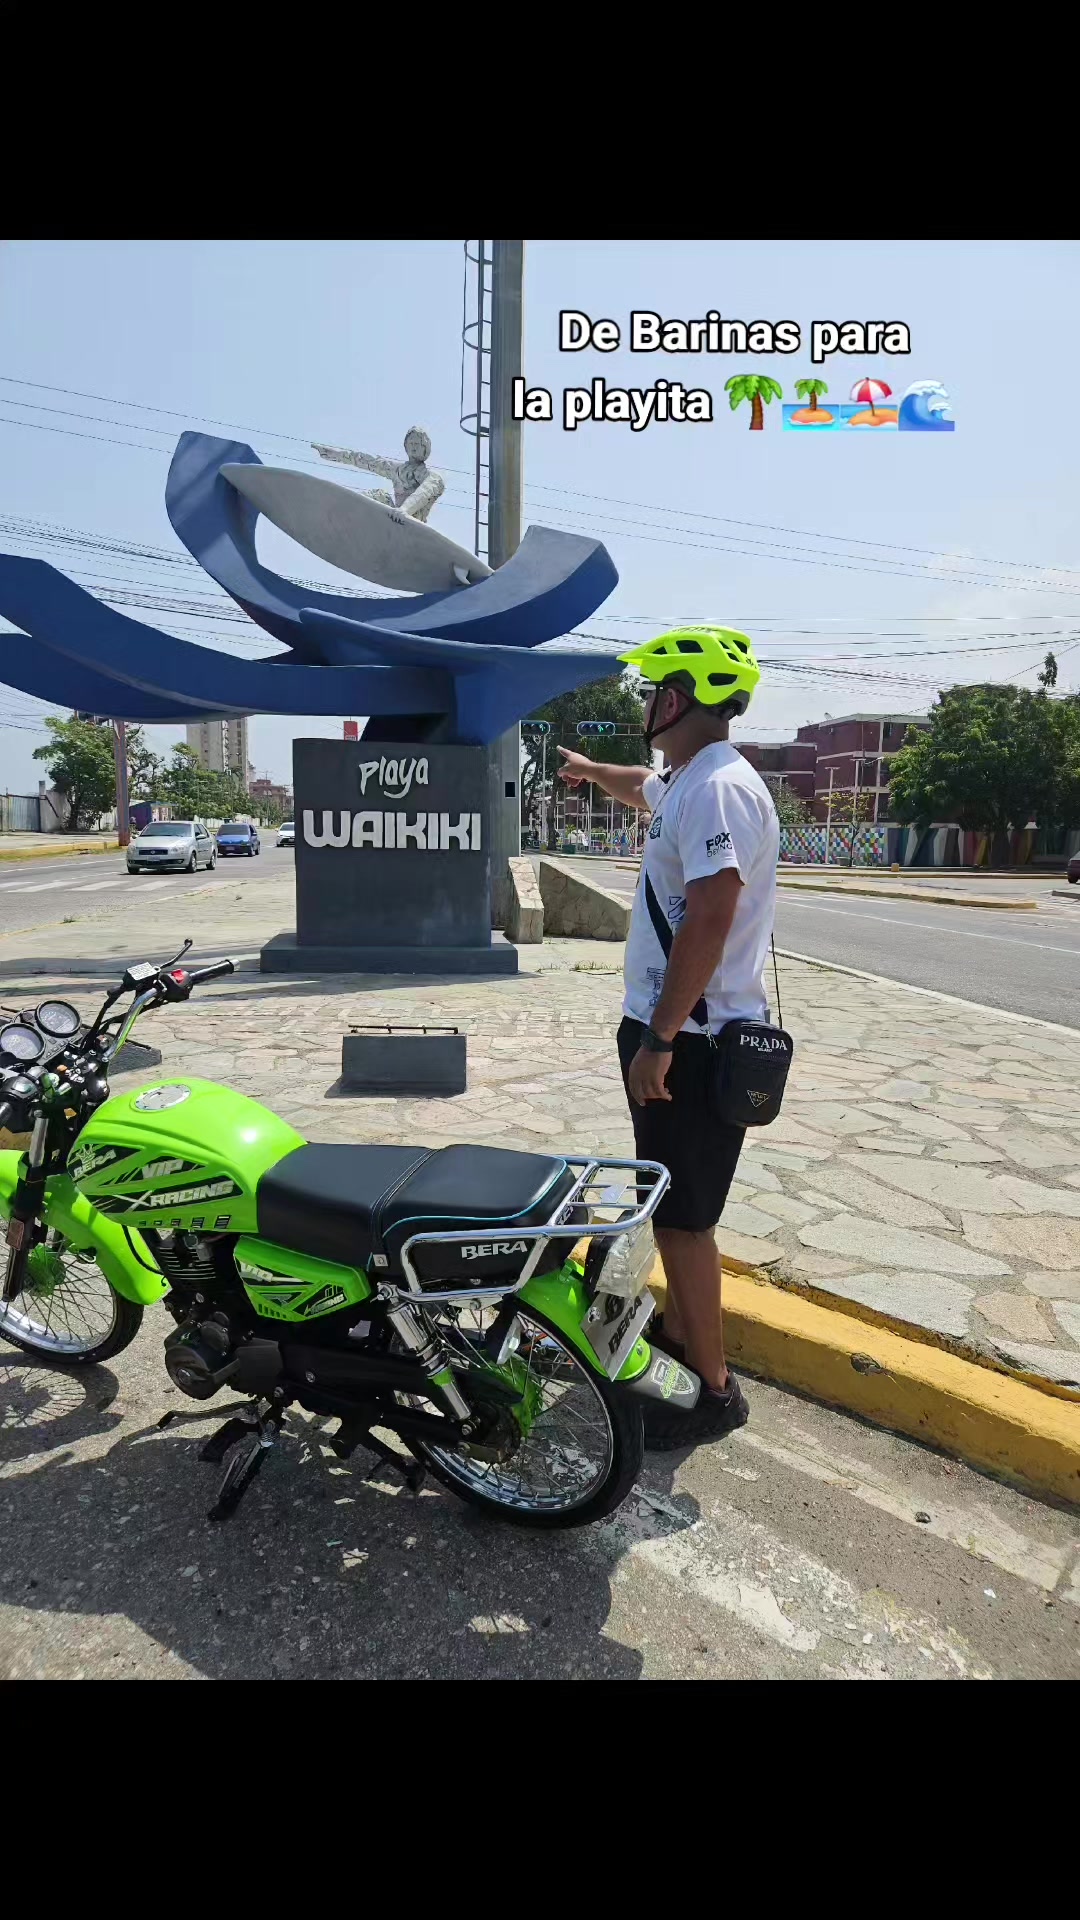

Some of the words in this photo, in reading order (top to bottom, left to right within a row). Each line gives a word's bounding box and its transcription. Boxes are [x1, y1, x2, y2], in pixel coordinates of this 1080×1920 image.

[302, 809, 482, 851] WAIKIKI
[705, 832, 731, 851] FOX
[739, 1034, 788, 1051] PRADA
[72, 1149, 117, 1181] BERA
[141, 1159, 184, 1180] VIP
[461, 1240, 528, 1260] BERA
[608, 1295, 643, 1355] BERA
